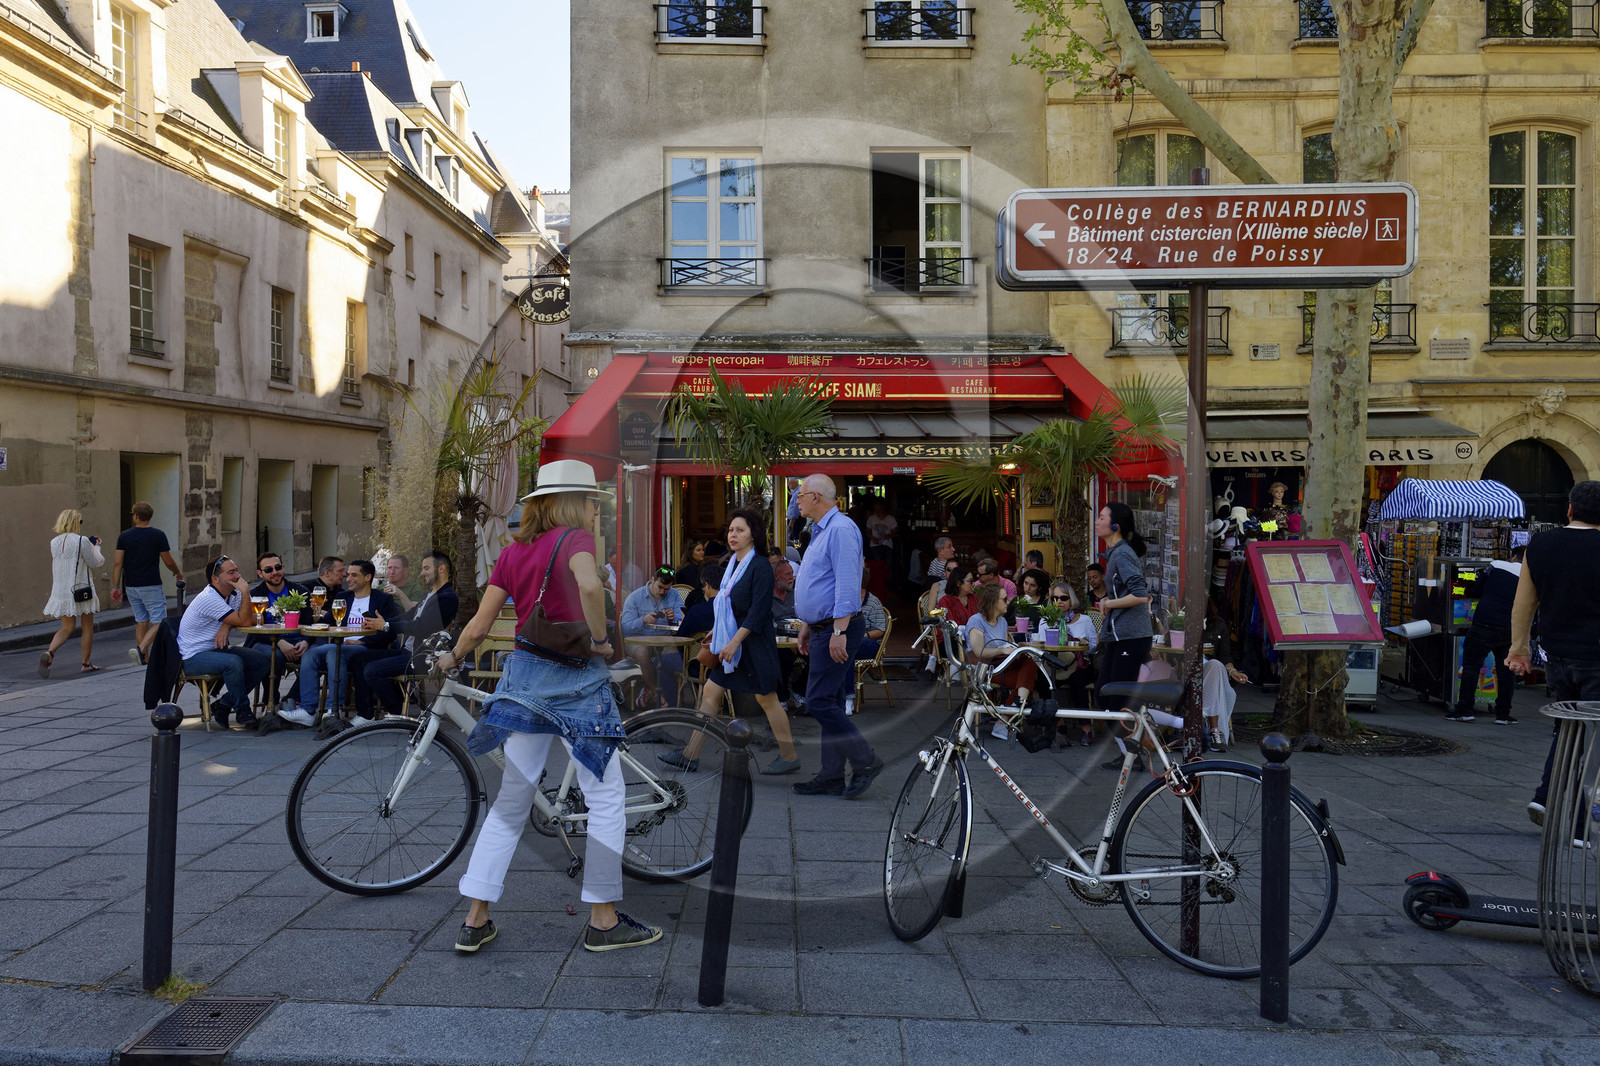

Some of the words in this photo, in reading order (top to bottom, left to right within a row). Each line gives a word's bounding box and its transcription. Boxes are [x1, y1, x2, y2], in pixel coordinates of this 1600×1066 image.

[1067, 203, 1152, 226] Collège
[1166, 202, 1203, 219] des
[1216, 199, 1367, 219] BERNARDINS
[1067, 224, 1144, 243] Bâtiment
[1150, 223, 1232, 242] cistercien
[1313, 218, 1370, 241] siècle)
[1066, 246, 1143, 267] 18/24,
[1157, 246, 1199, 264] Rue
[1213, 246, 1238, 263] de
[1250, 246, 1324, 265] Poissy
[531, 286, 566, 304] Café
[671, 354, 765, 367] кафе-ресторан
[951, 357, 973, 368] 카페
[692, 377, 711, 385] CAFE
[809, 382, 840, 398] CAFE
[844, 382, 876, 398] SIAM
[951, 386, 997, 394] RESTAURANT
[797, 446, 878, 457] averne
[1205, 449, 1306, 463] VENIRS
[1369, 449, 1434, 461] ARIS
[1224, 482, 1235, 503] 6
[993, 765, 1050, 827] PEUGEOT
[1482, 902, 1518, 914] Uber
